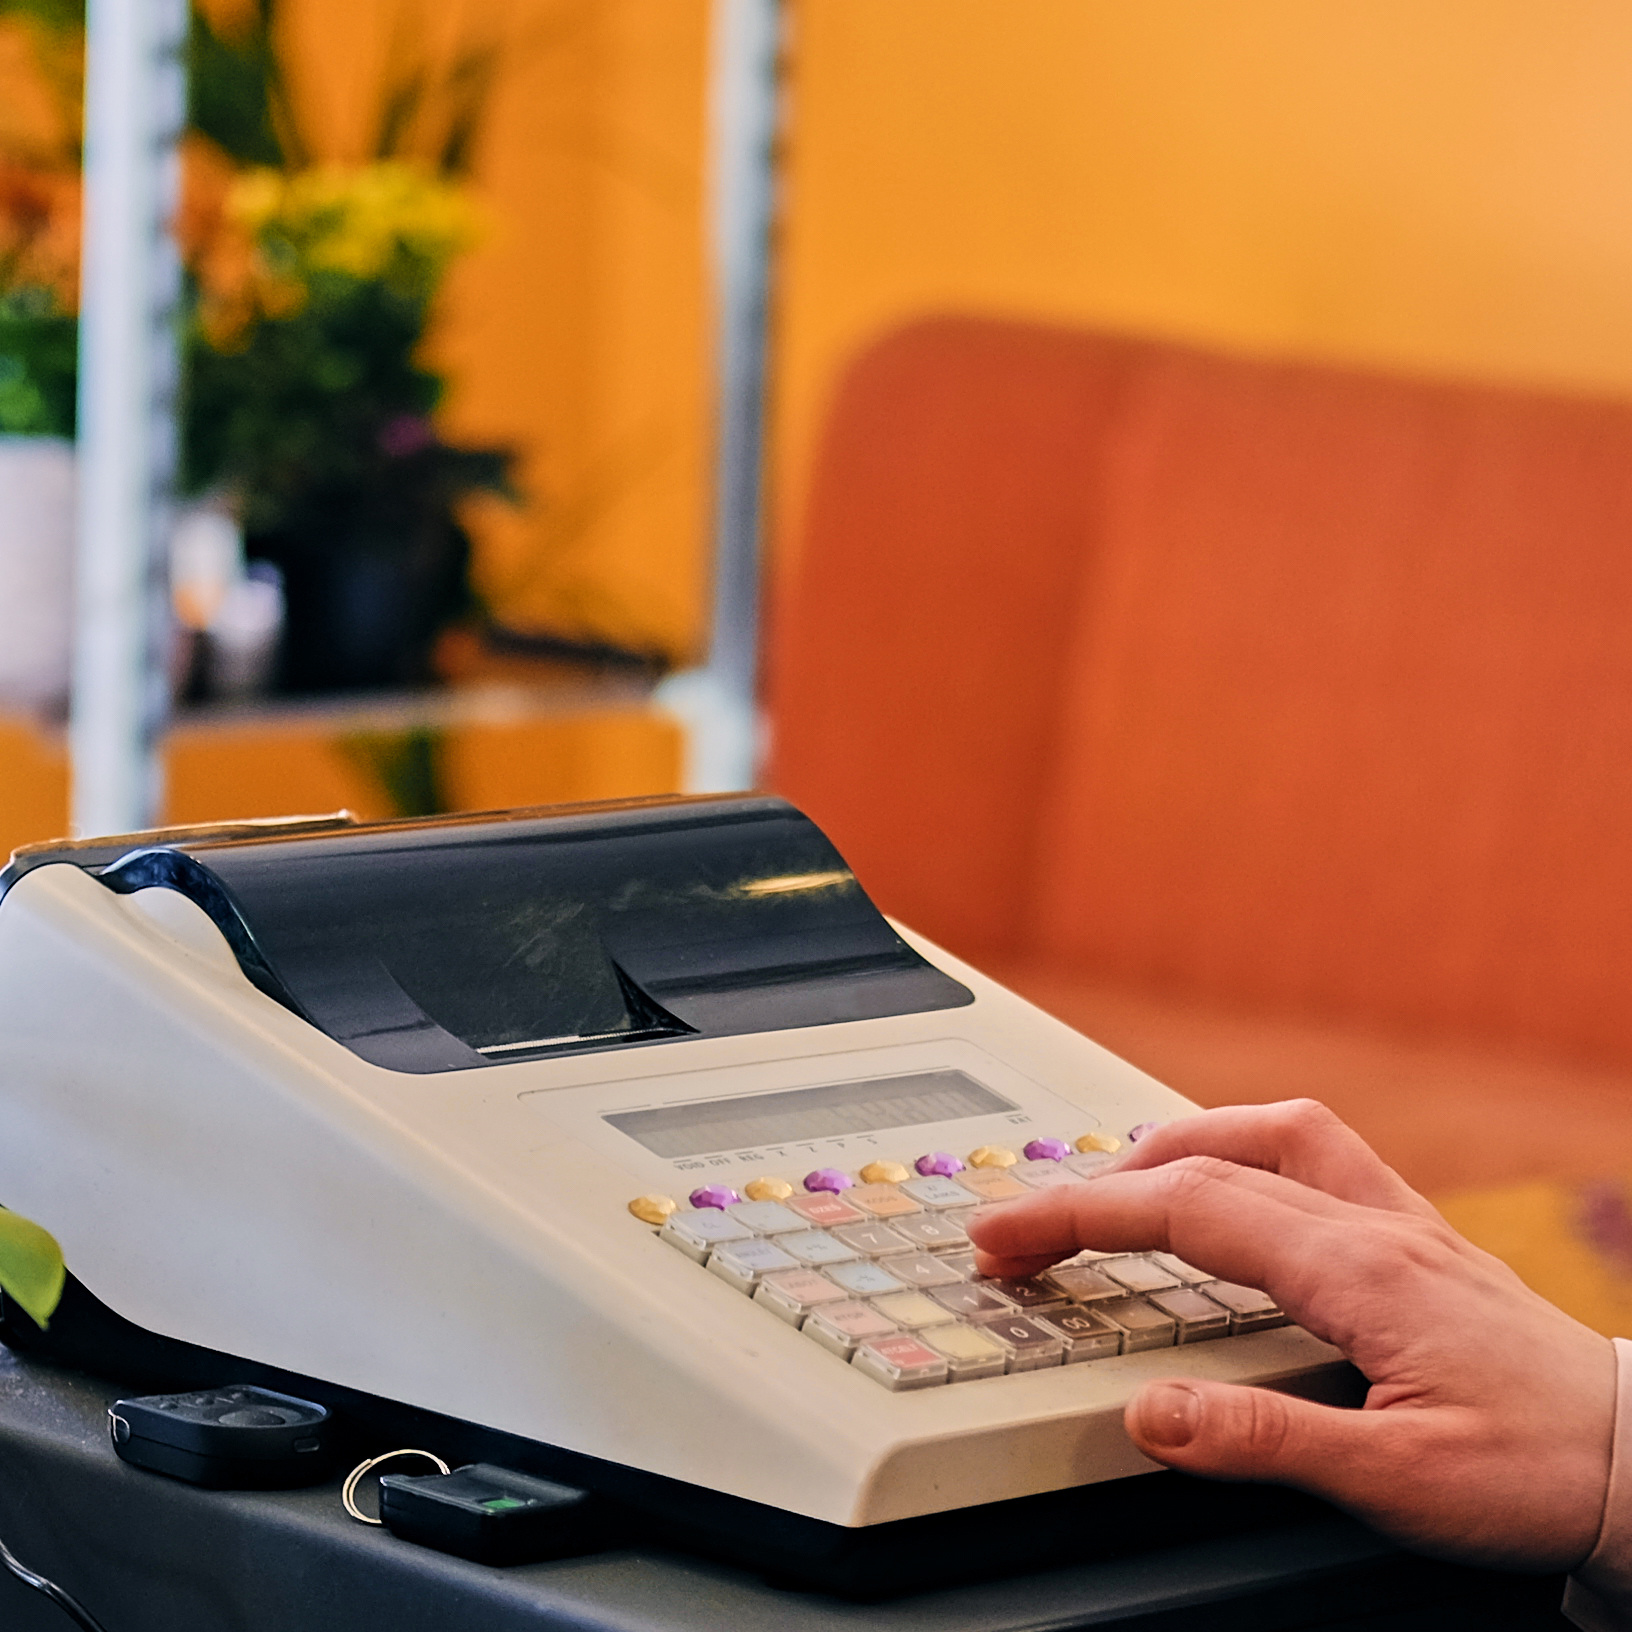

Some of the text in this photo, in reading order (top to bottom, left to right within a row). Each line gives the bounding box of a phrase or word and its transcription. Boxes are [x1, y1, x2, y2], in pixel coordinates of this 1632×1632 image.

[710, 1157, 731, 1167] OFF
[920, 1224, 940, 1236] 8
[861, 1232, 878, 1245] 7
[915, 1263, 930, 1274] 4
[1016, 1286, 1037, 1297] 2
[963, 1296, 979, 1307] 1
[1062, 1316, 1091, 1330] 00
[1009, 1326, 1029, 1339] 0
